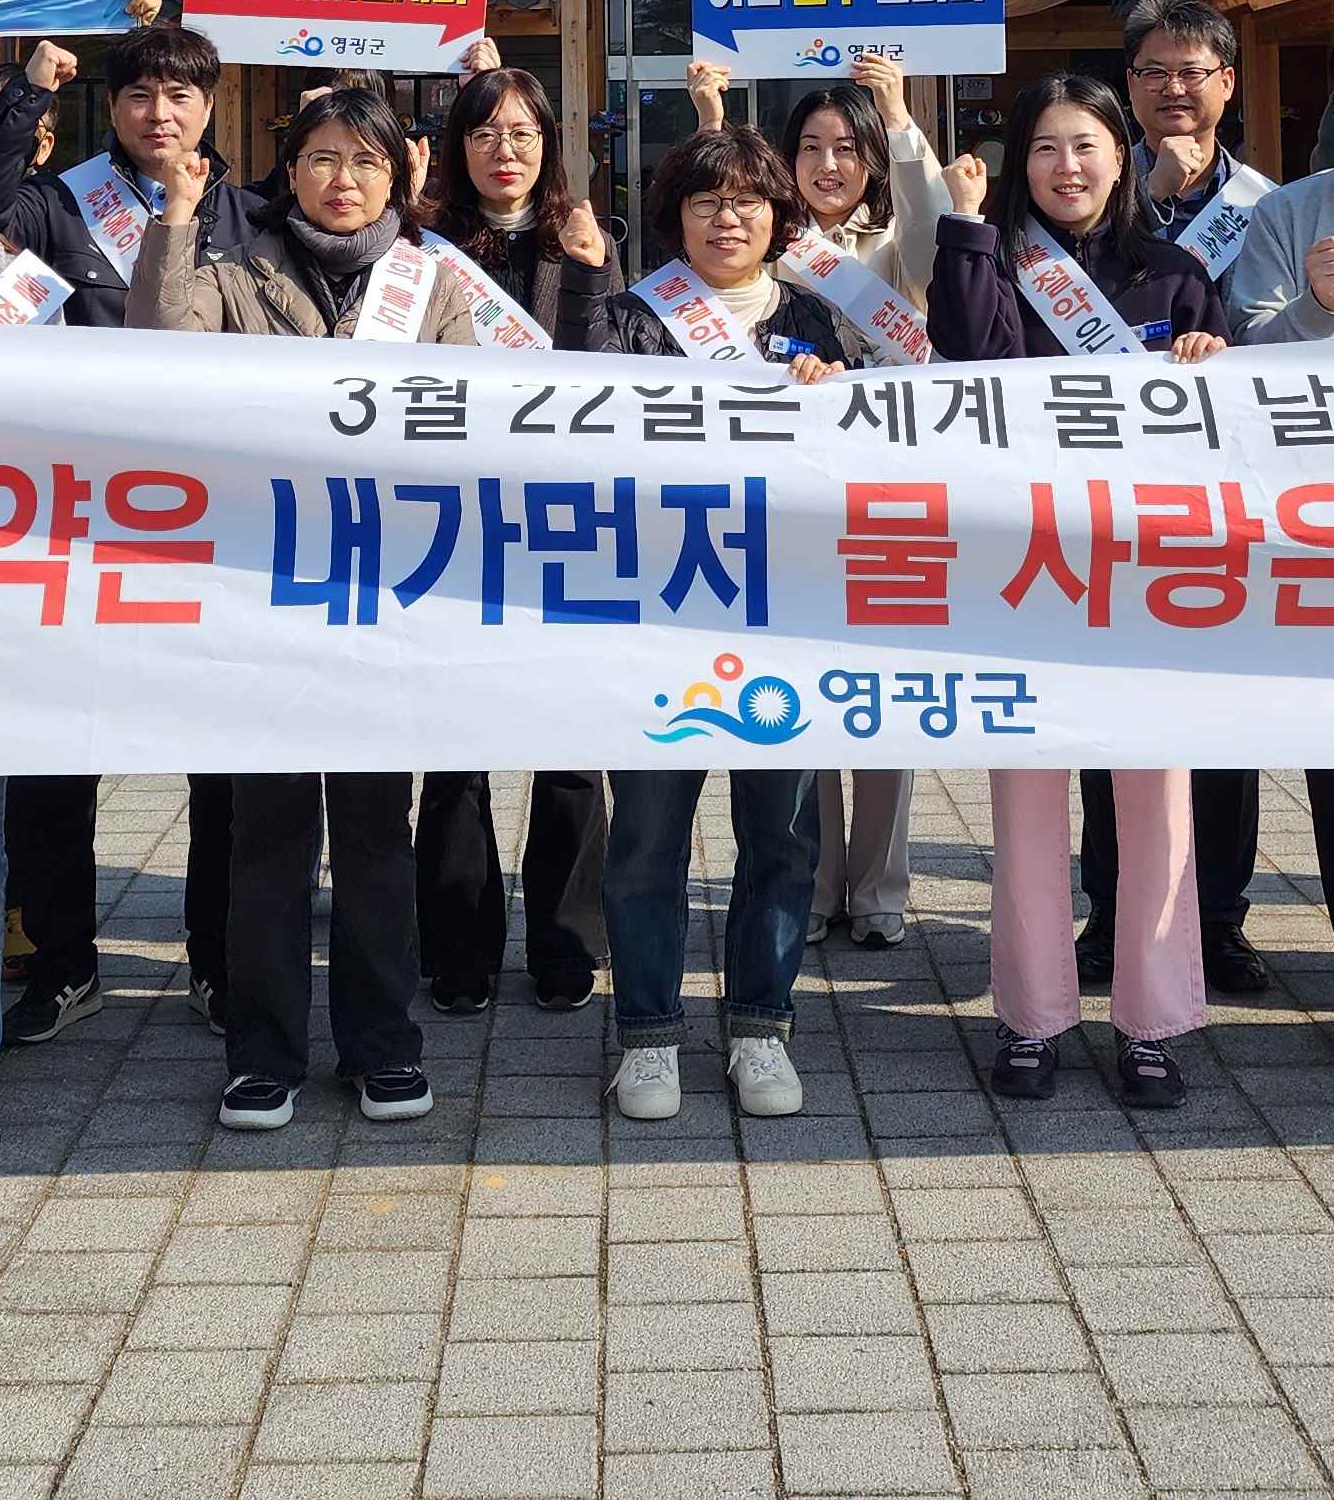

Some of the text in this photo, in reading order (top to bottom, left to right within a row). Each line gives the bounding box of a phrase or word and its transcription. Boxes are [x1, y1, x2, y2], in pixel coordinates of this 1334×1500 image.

[330, 35, 387, 56] 영광군
[847, 43, 905, 62] 영광군
[1196, 204, 1251, 260] 생활속
[1031, 263, 1116, 355] 절약은
[328, 375, 469, 442] 3월
[509, 384, 802, 443] 22일은
[837, 376, 1010, 450] 세계
[1043, 373, 1222, 451] 물의
[269, 475, 769, 628] 내가먼저
[835, 482, 958, 627] 물
[817, 668, 1038, 741] 영광군
